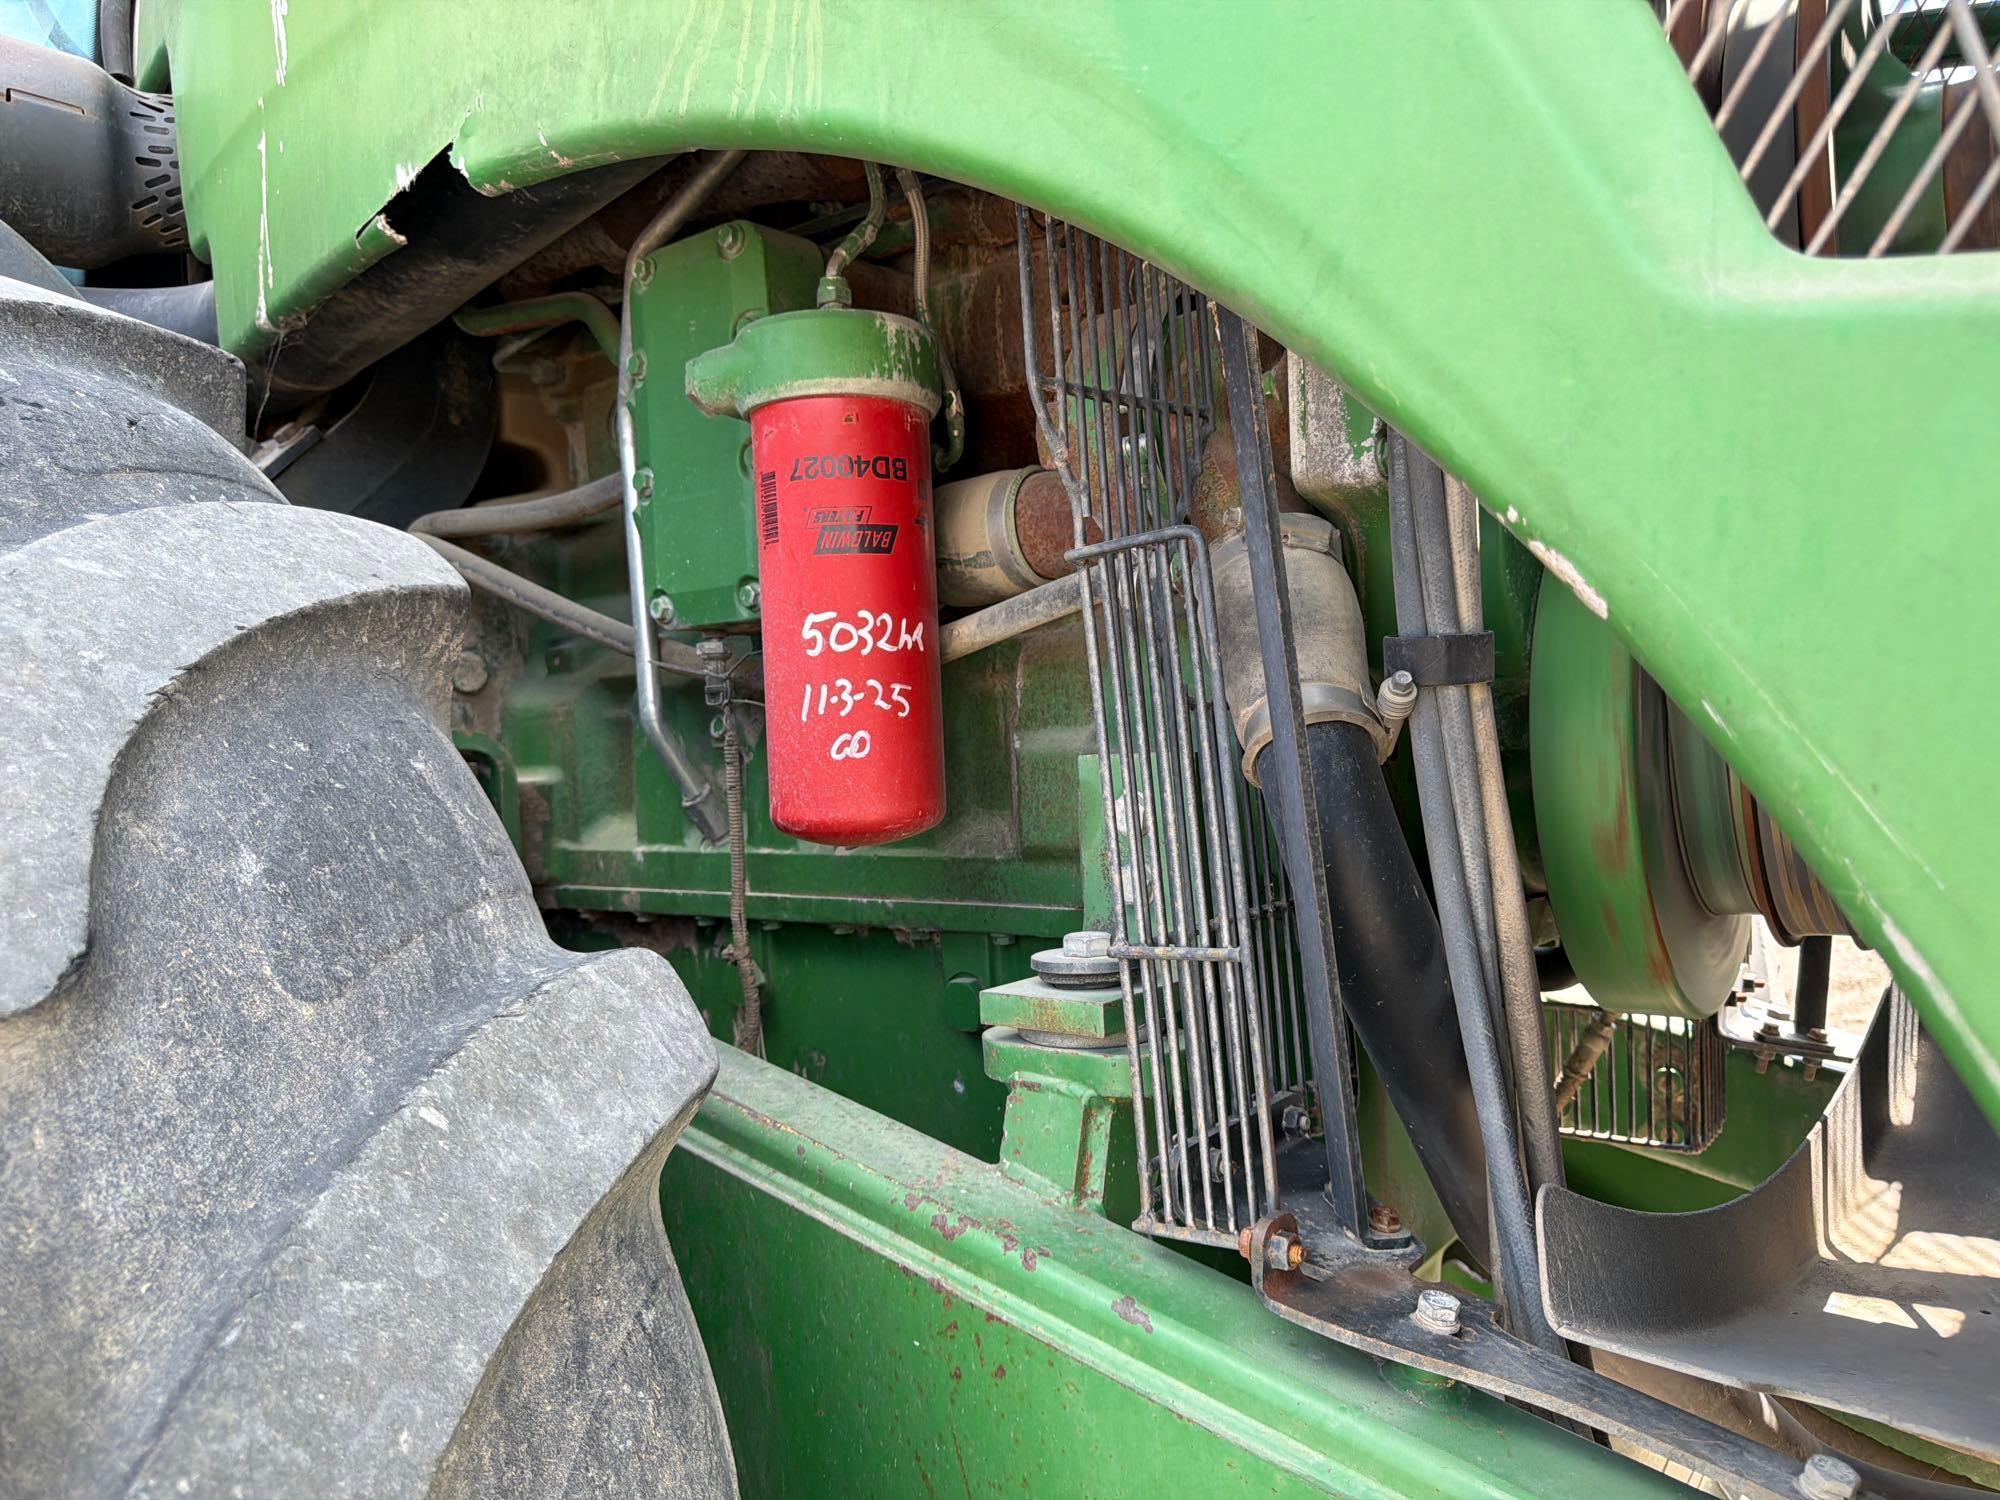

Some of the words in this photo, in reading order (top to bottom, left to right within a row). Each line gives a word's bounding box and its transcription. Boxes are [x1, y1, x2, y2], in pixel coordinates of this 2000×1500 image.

[790, 456, 908, 482] BD40027
[814, 510, 864, 523] FILTERS
[820, 530, 892, 549] BALDWIN
